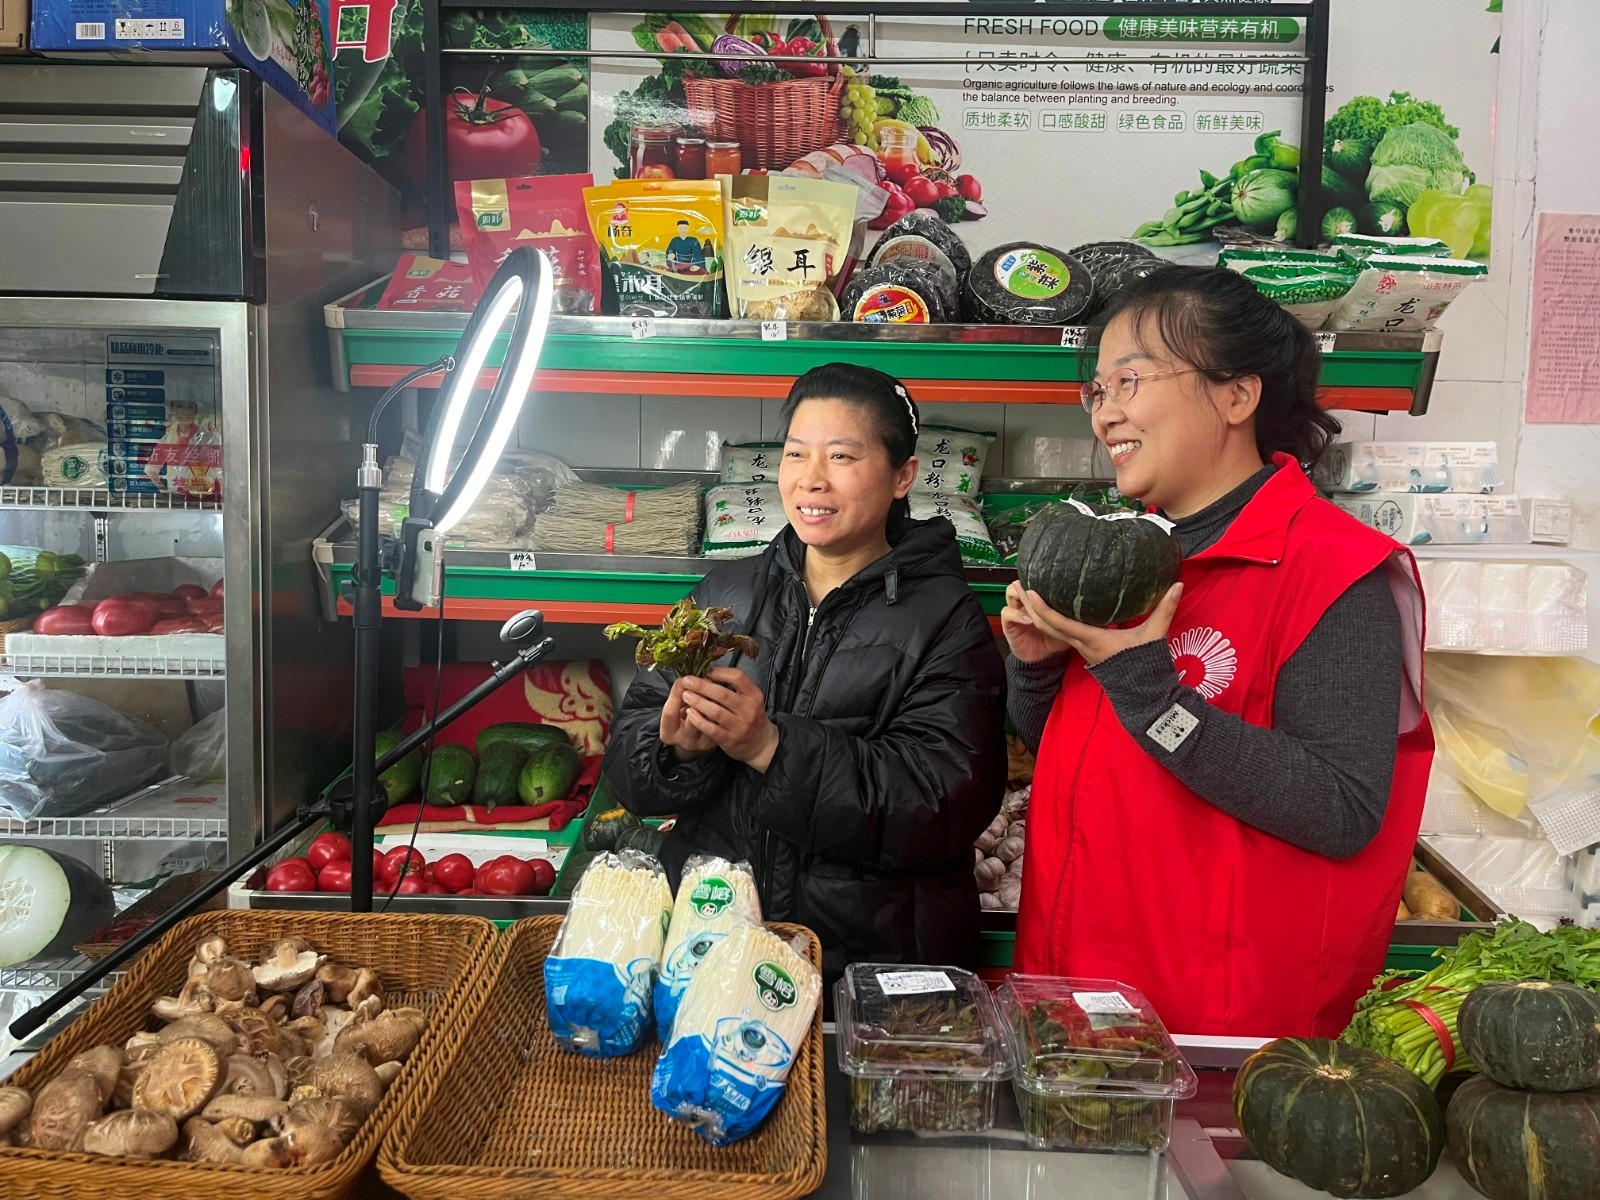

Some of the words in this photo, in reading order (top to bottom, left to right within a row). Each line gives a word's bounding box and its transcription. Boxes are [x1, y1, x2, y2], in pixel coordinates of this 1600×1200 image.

[964, 18, 1032, 35] FRESH
[1040, 19, 1099, 36] FOOD
[1119, 18, 1280, 39] 健康美味营养有机
[962, 79, 1002, 91] Organic
[1005, 79, 1058, 92] agriculture
[1060, 80, 1095, 90] follows
[1098, 80, 1114, 90] the
[1116, 81, 1139, 91] laws
[1142, 81, 1152, 91] of
[1154, 82, 1187, 92] nature
[1189, 82, 1209, 92] and
[1211, 82, 1251, 94] ecology
[1253, 82, 1273, 92] and
[962, 93, 978, 101] the
[981, 93, 1020, 102] balance
[1023, 93, 1065, 103] between
[1068, 94, 1108, 105] planting
[1111, 95, 1130, 104] and
[1132, 95, 1179, 106] breeding.
[964, 111, 1029, 127] 质地柔软
[1042, 113, 1106, 129] 口感酸甜
[1118, 114, 1183, 130] 绿色食品
[1196, 114, 1261, 131] 新鲜美味
[743, 243, 816, 279] 银耳
[1422, 282, 1462, 292] 山东特产
[750, 453, 768, 483] 龙口
[924, 438, 952, 489] 龙口粉
[1156, 710, 1180, 735] Mickey
[692, 883, 731, 901] 雪榕
[758, 964, 795, 1000] 雪榕
